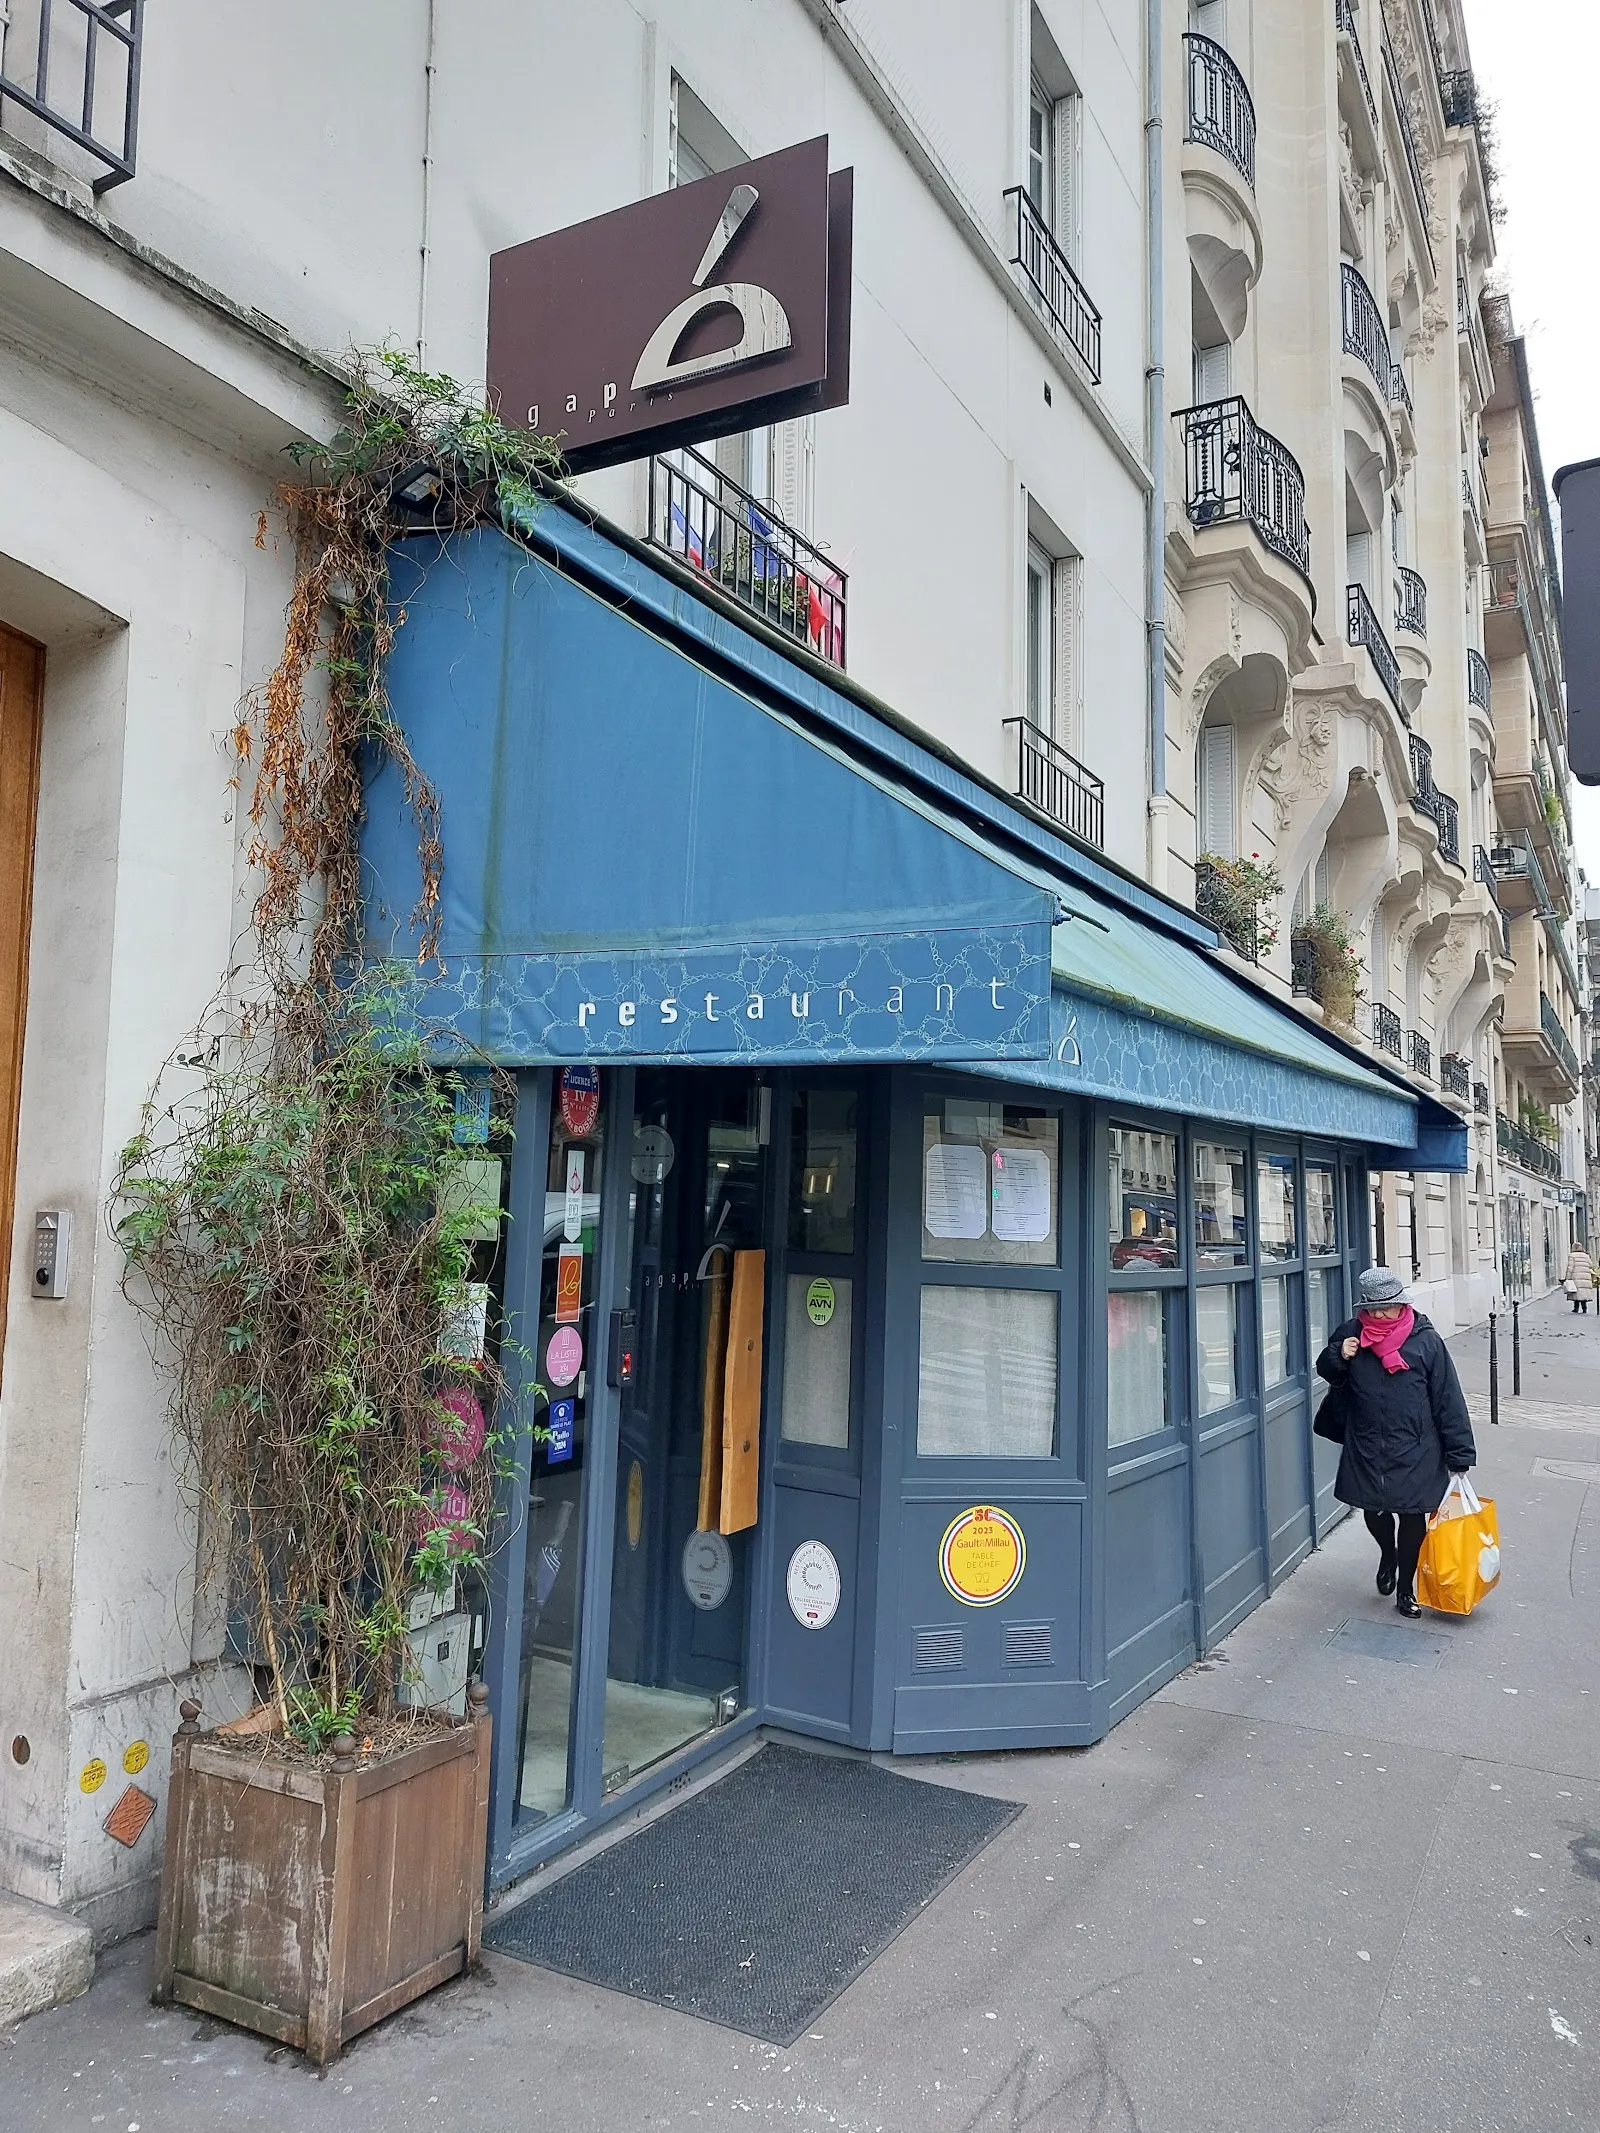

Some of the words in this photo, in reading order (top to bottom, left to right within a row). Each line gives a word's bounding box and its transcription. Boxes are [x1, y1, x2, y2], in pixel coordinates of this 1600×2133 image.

[578, 976, 1005, 1027] restaurant
[570, 1075, 591, 1087] LICENCE
[575, 1089, 586, 1102] IV
[574, 1095, 598, 1133] BOISSONS
[809, 1298, 832, 1309] AVN
[972, 1526, 993, 1535] 2023
[793, 1548, 815, 1575] RESTAURANT
[971, 1552, 995, 1560] TABLE
[966, 1561, 977, 1569] DE
[978, 1560, 1000, 1568] CHEF
